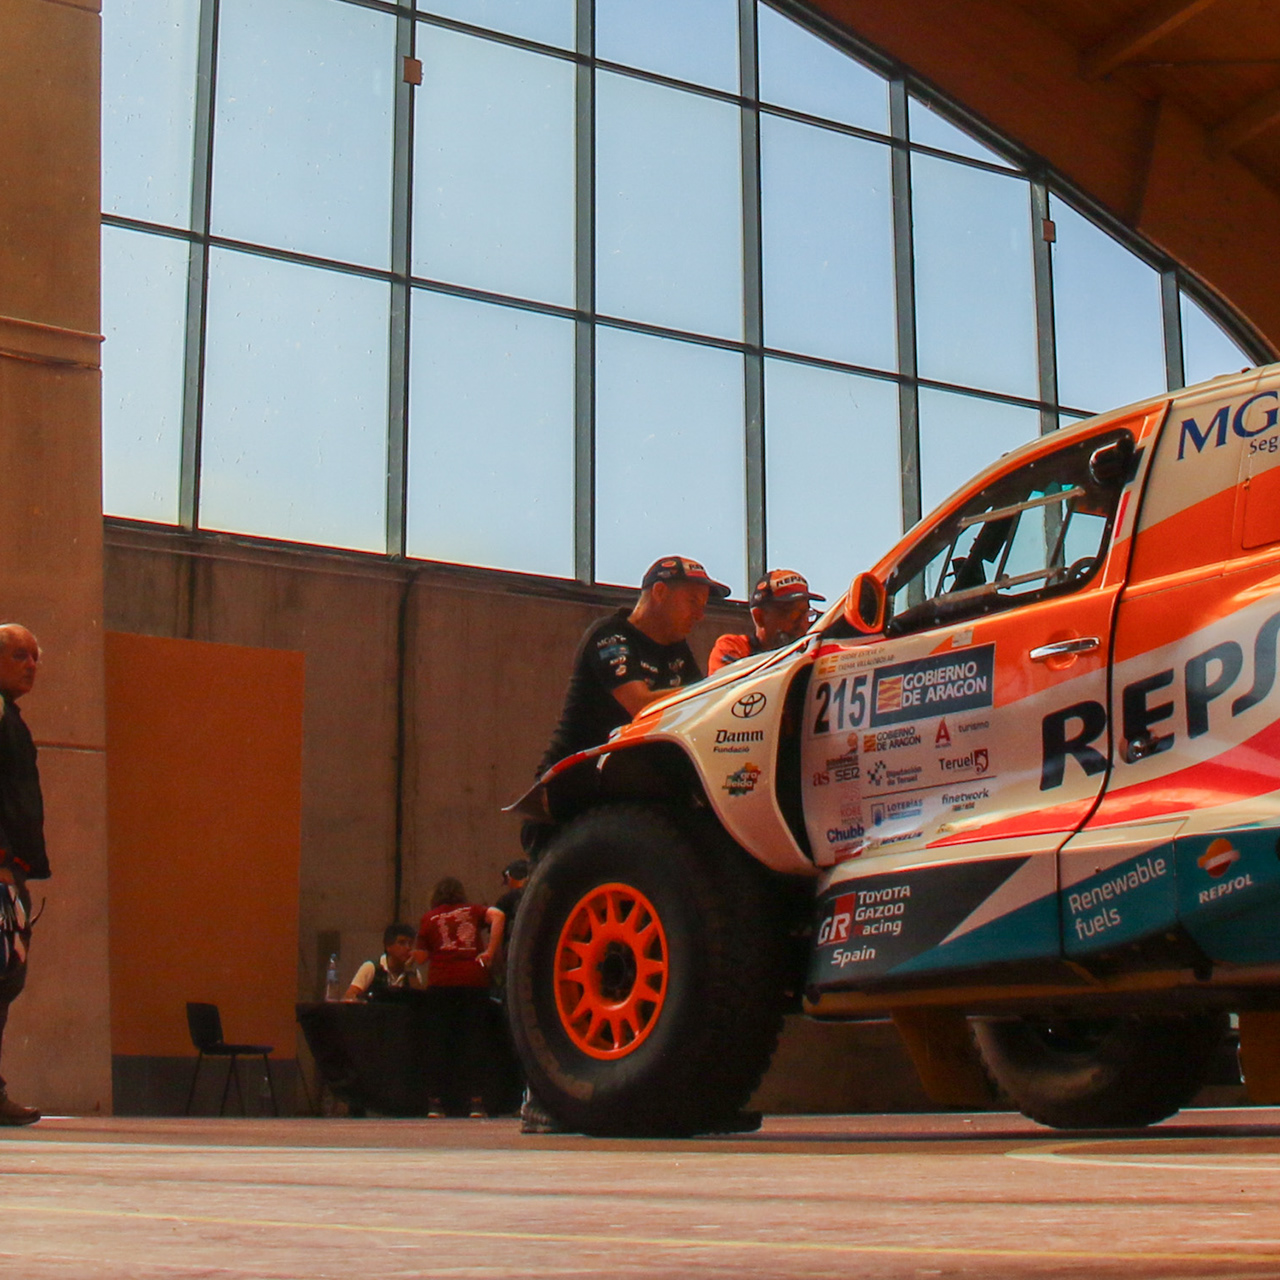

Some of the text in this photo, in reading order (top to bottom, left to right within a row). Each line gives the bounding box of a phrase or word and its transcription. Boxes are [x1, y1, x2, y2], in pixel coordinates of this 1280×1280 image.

[903, 661, 977, 690] GOBIERNO
[902, 676, 987, 708] DE ARAGON
[813, 674, 868, 734] 215
[715, 729, 764, 743] Damm
[877, 726, 916, 741] GOBIERNO
[958, 721, 989, 733] turismo
[877, 741, 887, 752] DE
[939, 752, 974, 771] Teruel
[813, 771, 830, 787] as
[835, 767, 860, 782] SER
[941, 787, 989, 805] finetwork
[827, 824, 865, 843] Chubb
[858, 885, 911, 904] TOYOTA
[1068, 858, 1167, 915] Renewable
[1198, 873, 1254, 904] REPSOL
[855, 902, 904, 921] GAZOO
[817, 912, 851, 945] GR
[1074, 907, 1121, 940] fuels
[830, 945, 876, 968] Spain
